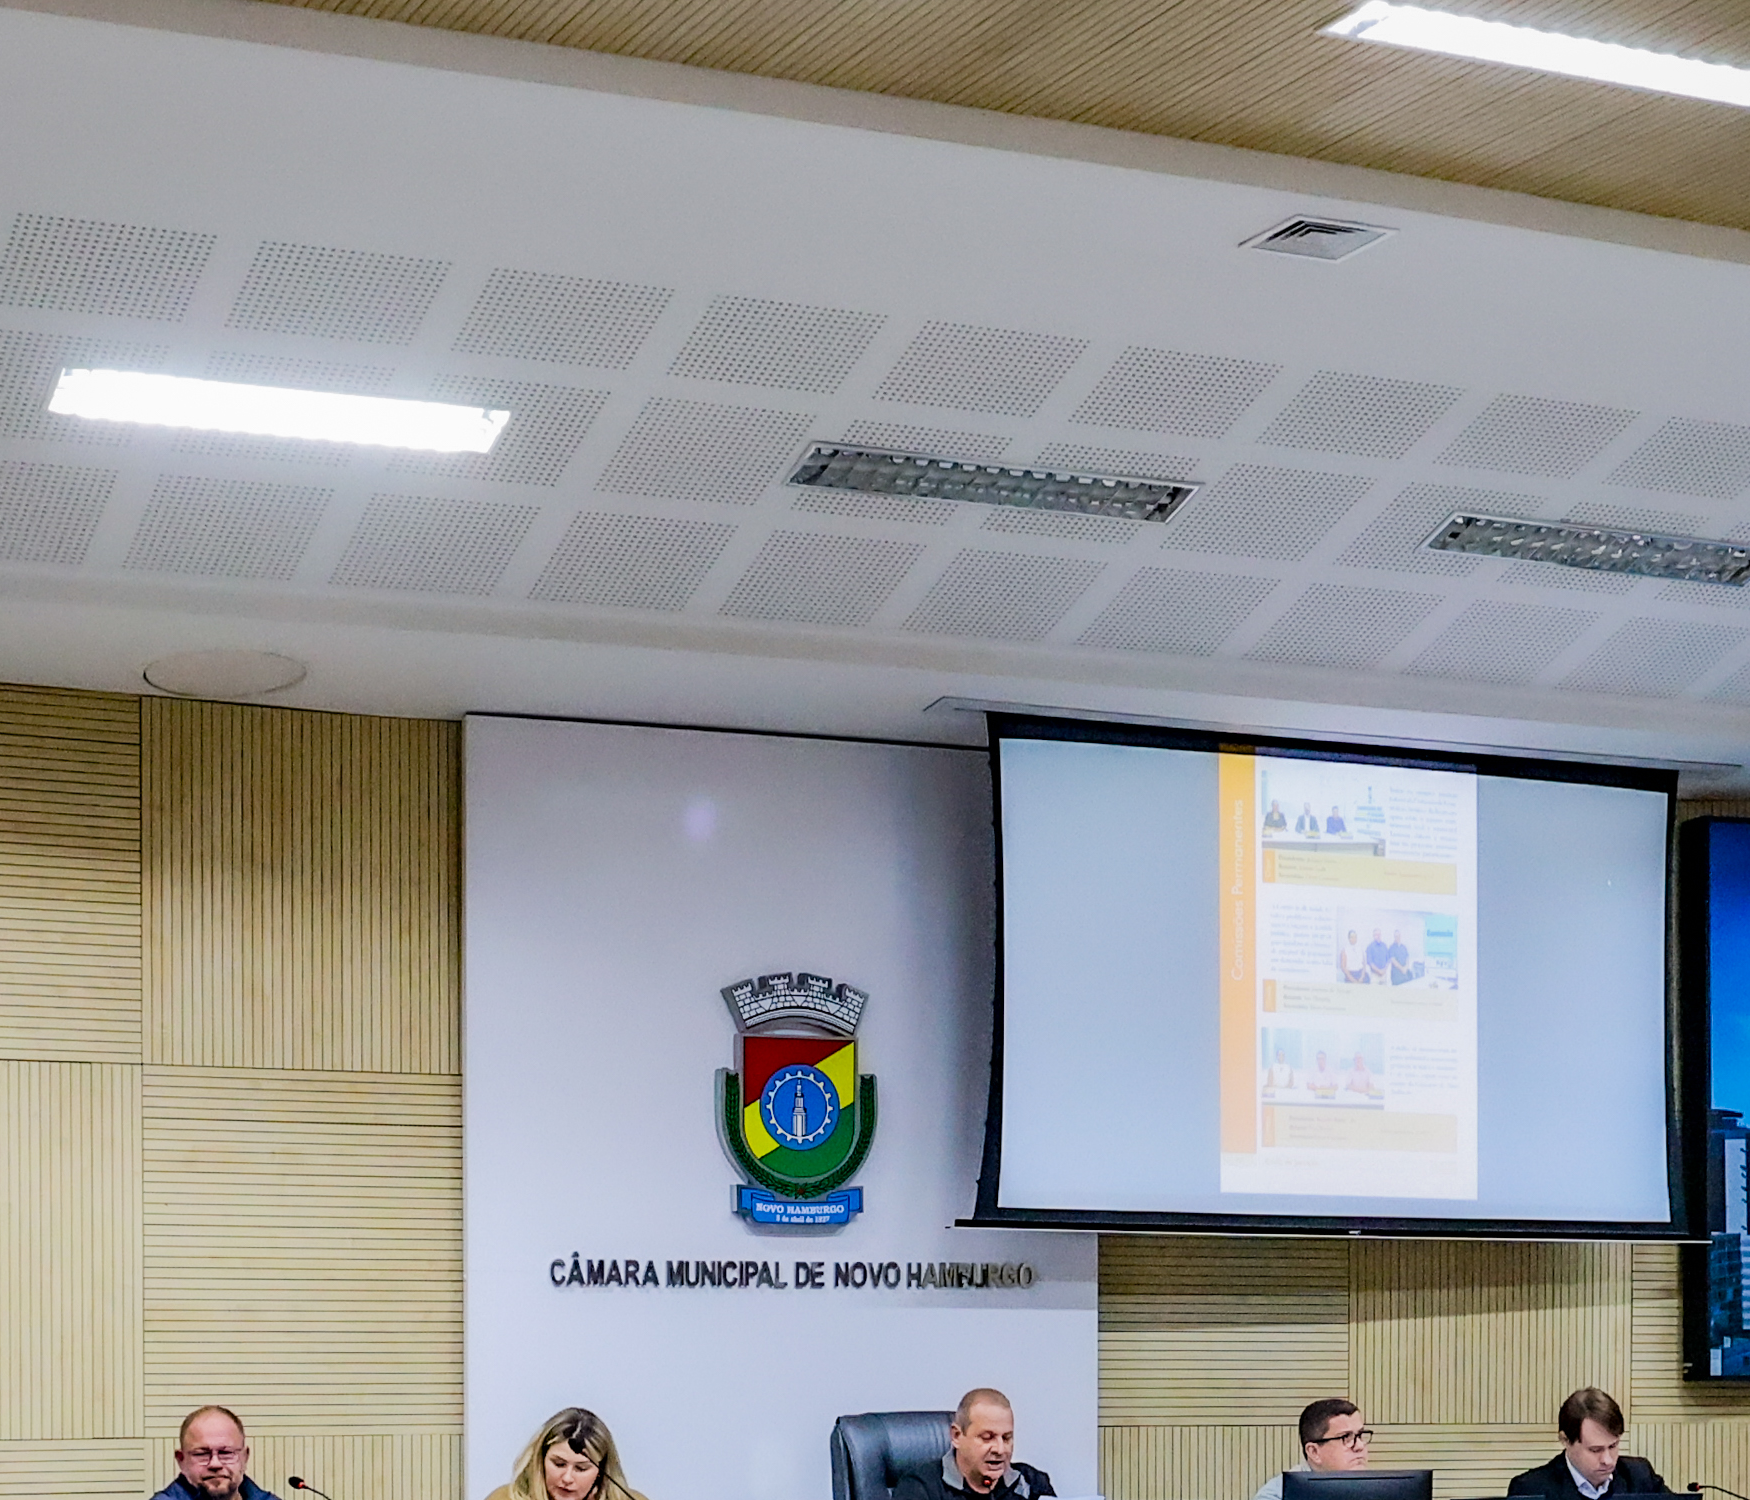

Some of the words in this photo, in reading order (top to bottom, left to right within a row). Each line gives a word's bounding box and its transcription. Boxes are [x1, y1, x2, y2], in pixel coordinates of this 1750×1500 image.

[755, 1202, 785, 1214] NOVO
[786, 1204, 845, 1215] HAMBURGO
[550, 1252, 659, 1288] CÂMARA
[666, 1259, 788, 1289] MUNICIPAL
[794, 1260, 824, 1288] DE
[834, 1260, 901, 1288] NOVO
[907, 1261, 1035, 1289] HAMBURGO
